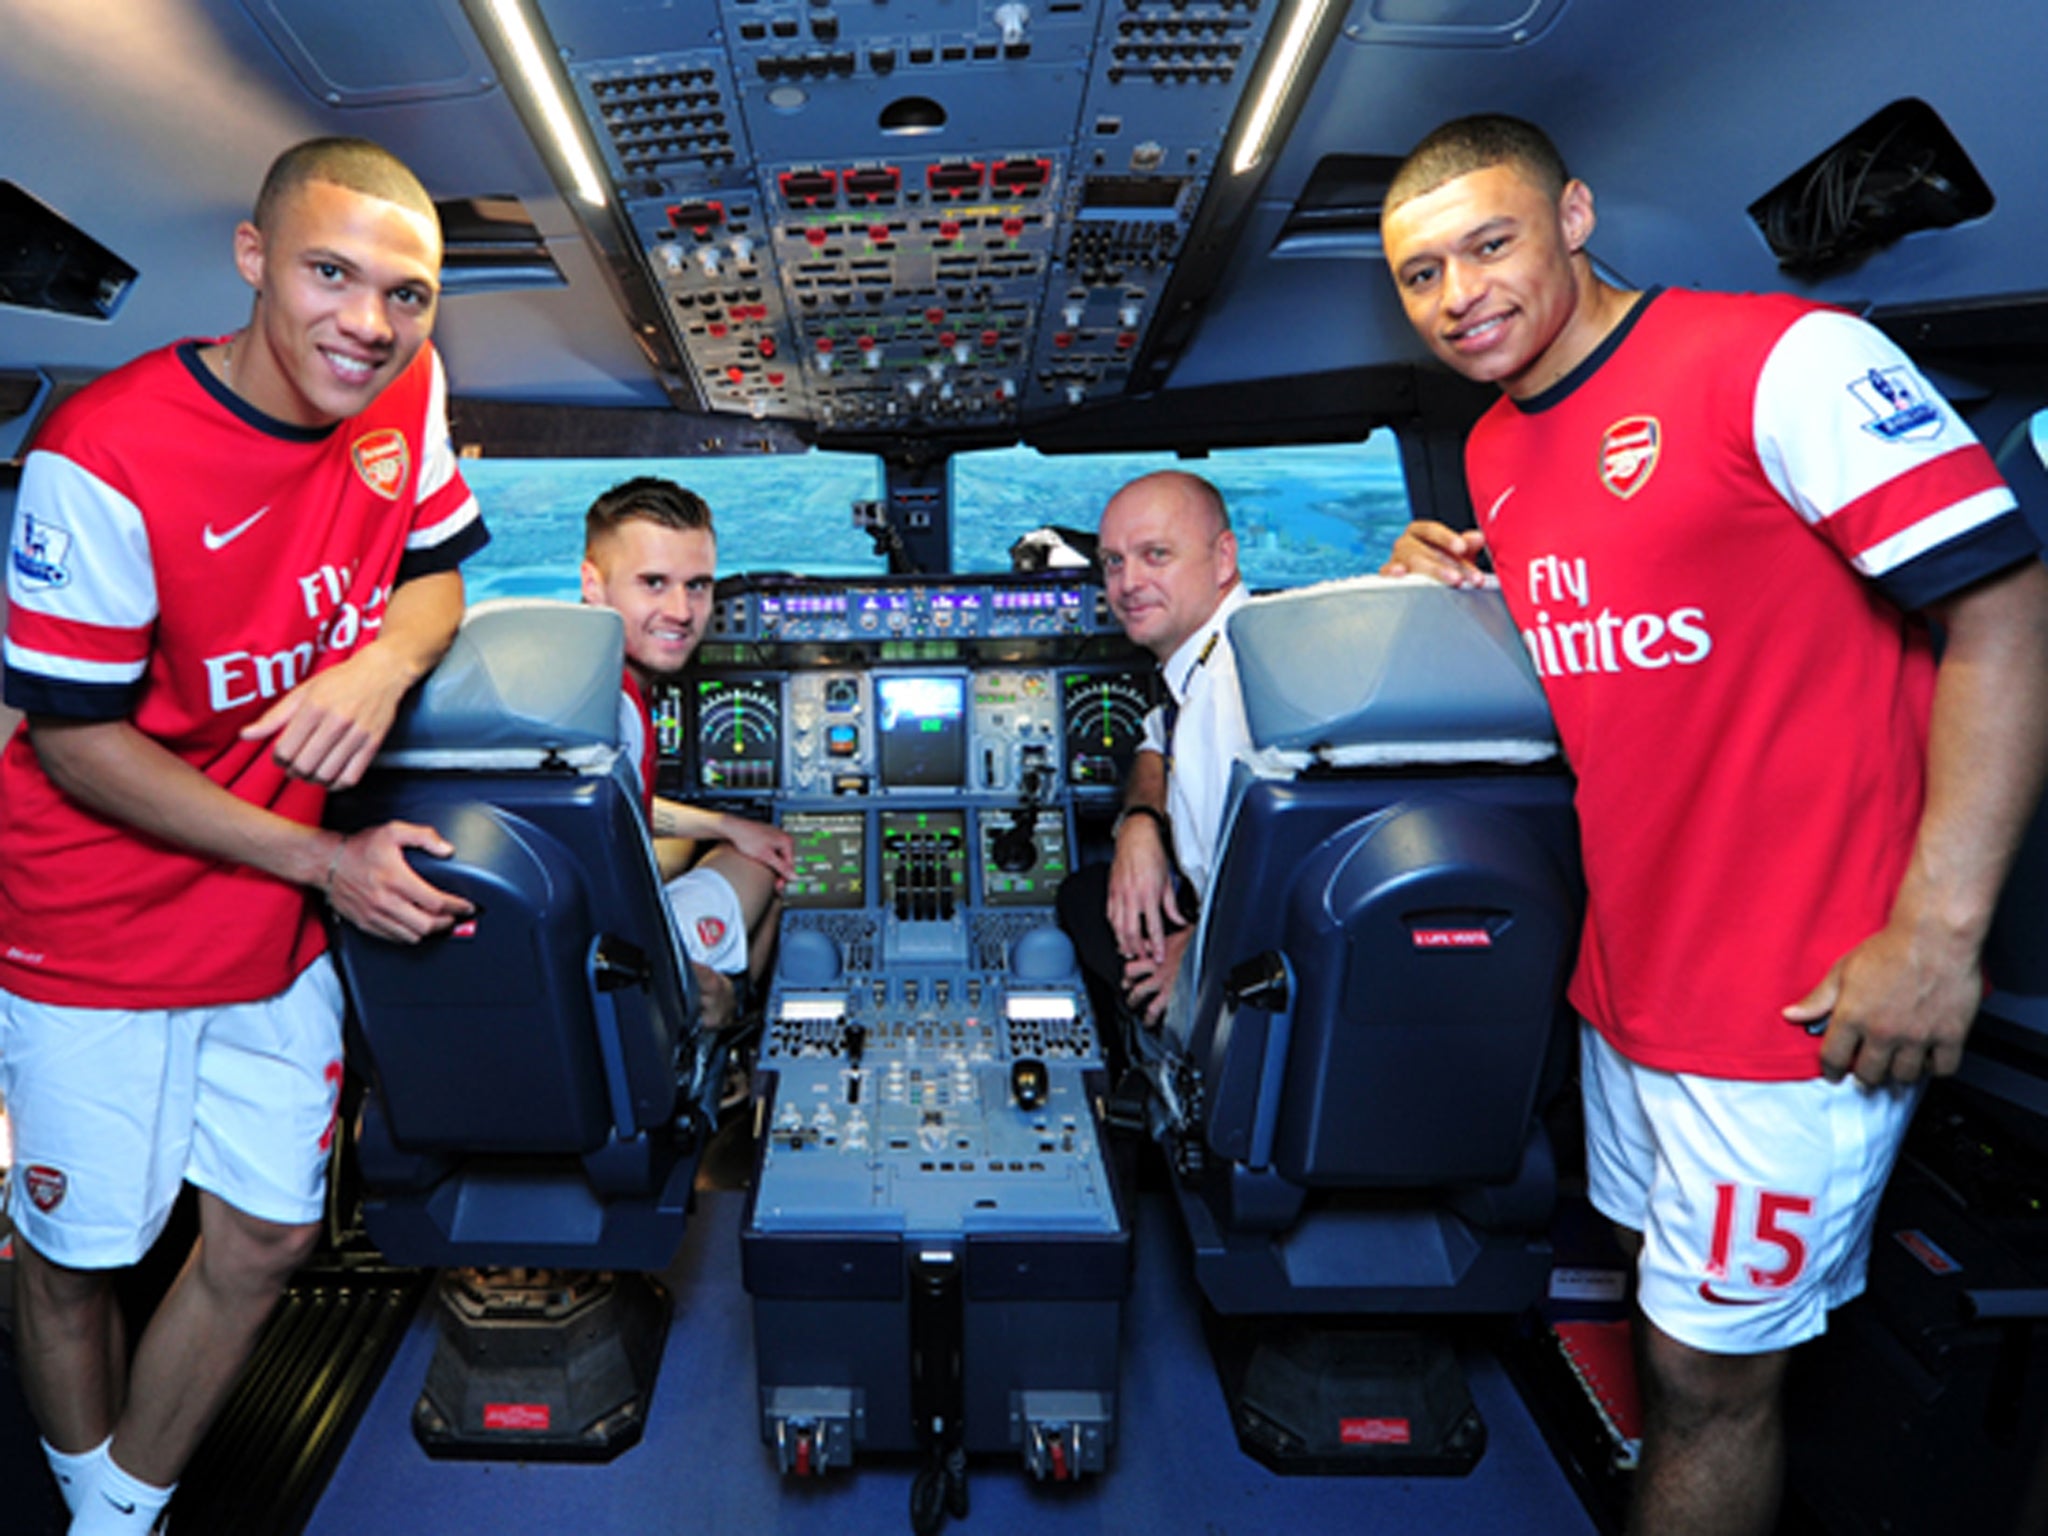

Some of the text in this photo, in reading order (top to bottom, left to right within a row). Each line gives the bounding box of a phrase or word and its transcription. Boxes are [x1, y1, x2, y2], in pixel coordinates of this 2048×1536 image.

[1528, 554, 1590, 608] Fly
[1523, 606, 1713, 677] irtes
[1705, 1183, 1813, 1289] 15
